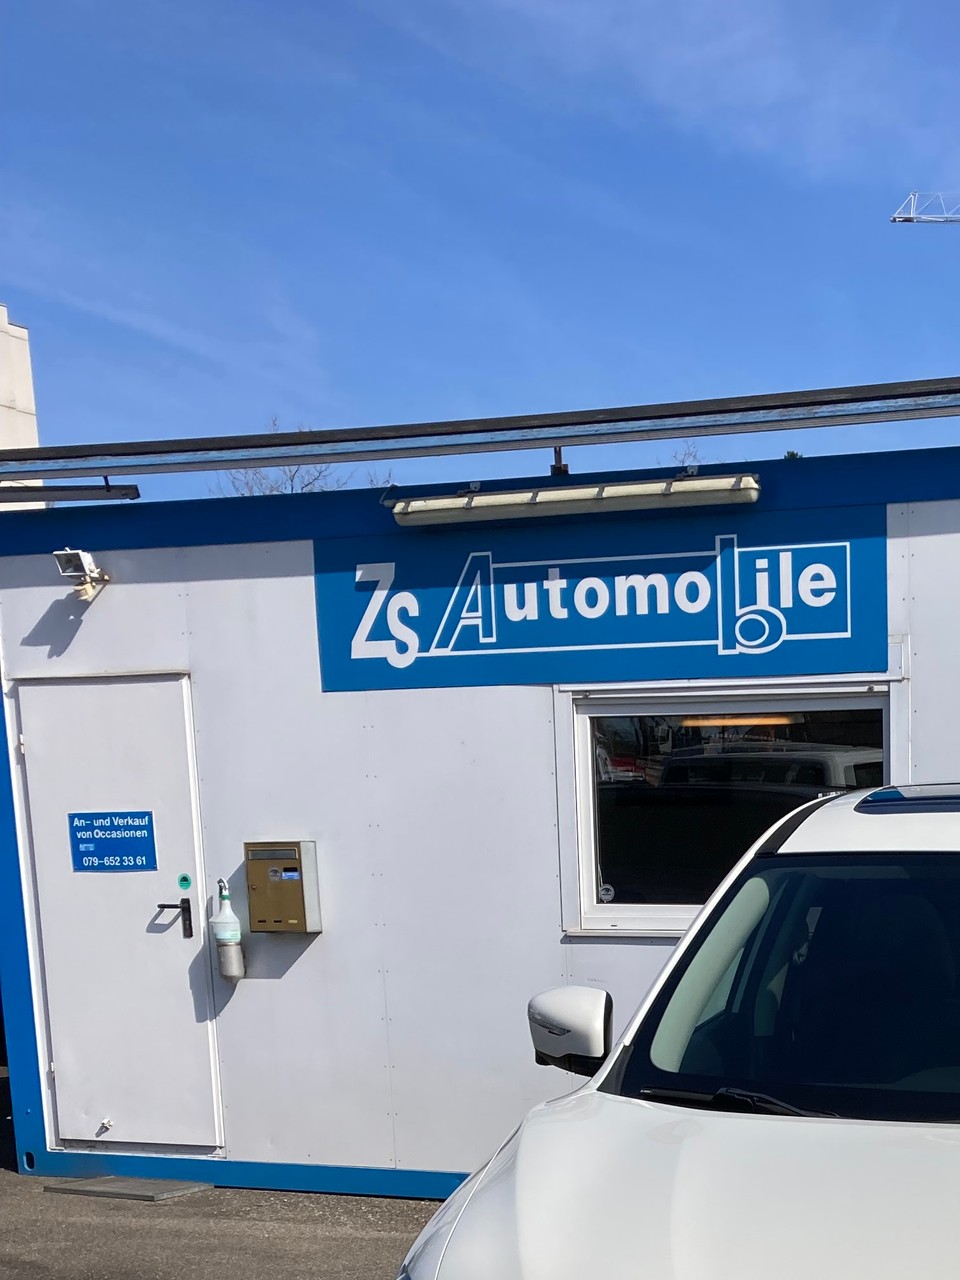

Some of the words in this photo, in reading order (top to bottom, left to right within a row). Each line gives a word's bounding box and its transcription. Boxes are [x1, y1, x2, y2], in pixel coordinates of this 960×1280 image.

[429, 533, 837, 655] Automobile
[93, 816, 111, 826] und
[112, 815, 149, 826] Verkauf
[93, 828, 148, 838] Occasionen
[122, 856, 134, 866] 33
[136, 856, 146, 866] 61
